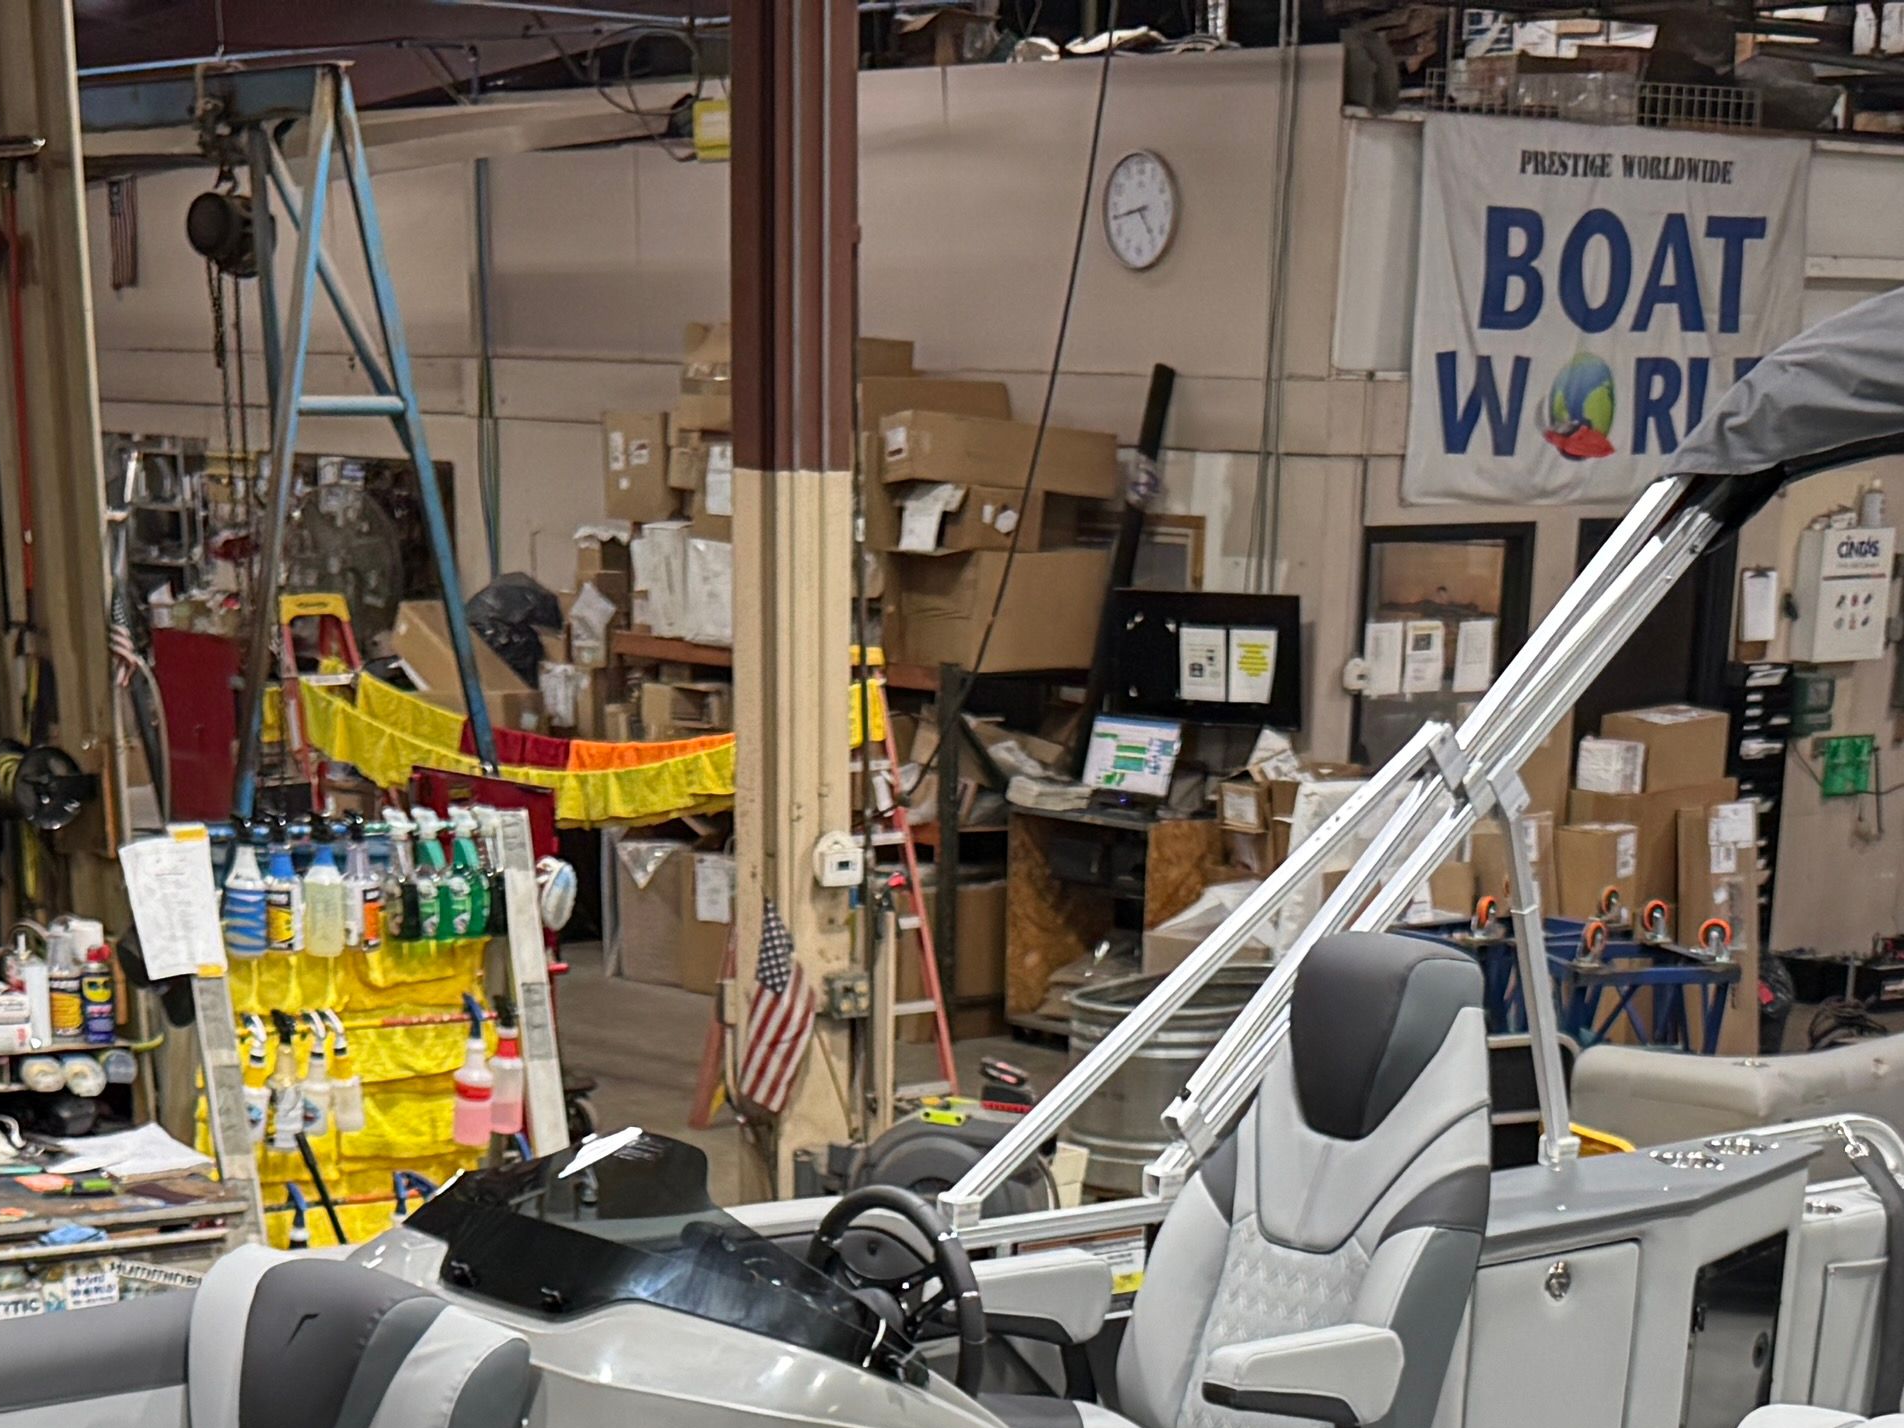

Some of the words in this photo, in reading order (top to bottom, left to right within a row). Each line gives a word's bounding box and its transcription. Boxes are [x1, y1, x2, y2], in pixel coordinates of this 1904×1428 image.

[1520, 149, 1614, 179] PRESTIGE
[1621, 153, 1734, 185] WORLDWIDE
[1477, 205, 1768, 335] BOAT
[1837, 535, 1880, 559] CINTAS
